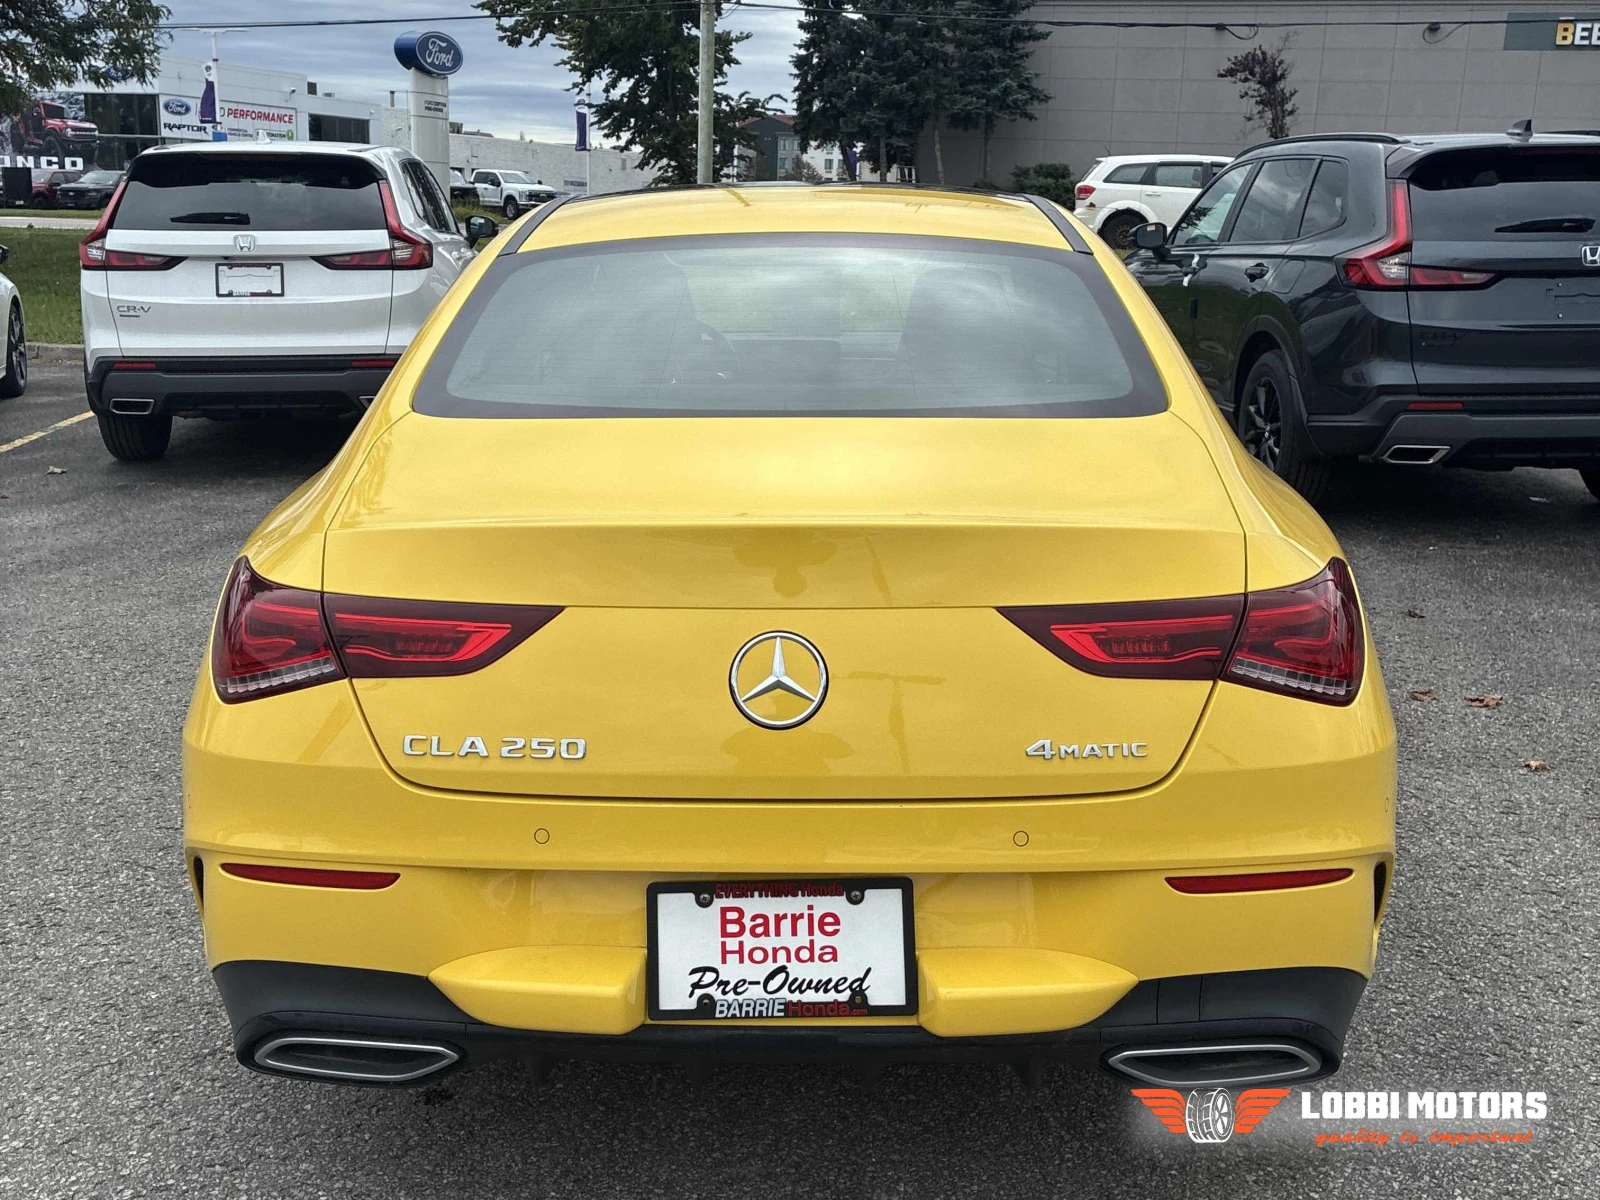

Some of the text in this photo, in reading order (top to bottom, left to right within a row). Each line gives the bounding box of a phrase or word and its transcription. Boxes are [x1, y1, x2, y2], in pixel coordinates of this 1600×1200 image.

[425, 38, 454, 68] Ford
[167, 101, 187, 114] Ford
[226, 106, 294, 124] PERFORMANCE
[163, 122, 209, 135] RAPTOR
[116, 305, 152, 313] CR-V
[403, 735, 586, 759] CLA 250
[1026, 739, 1148, 759] 4MATIC
[715, 881, 845, 899] EVERYTHING Honda
[719, 905, 841, 939] Barrie
[720, 939, 838, 965] Honda
[688, 964, 872, 998] Pre-Owned
[715, 998, 786, 1018] BARRIE
